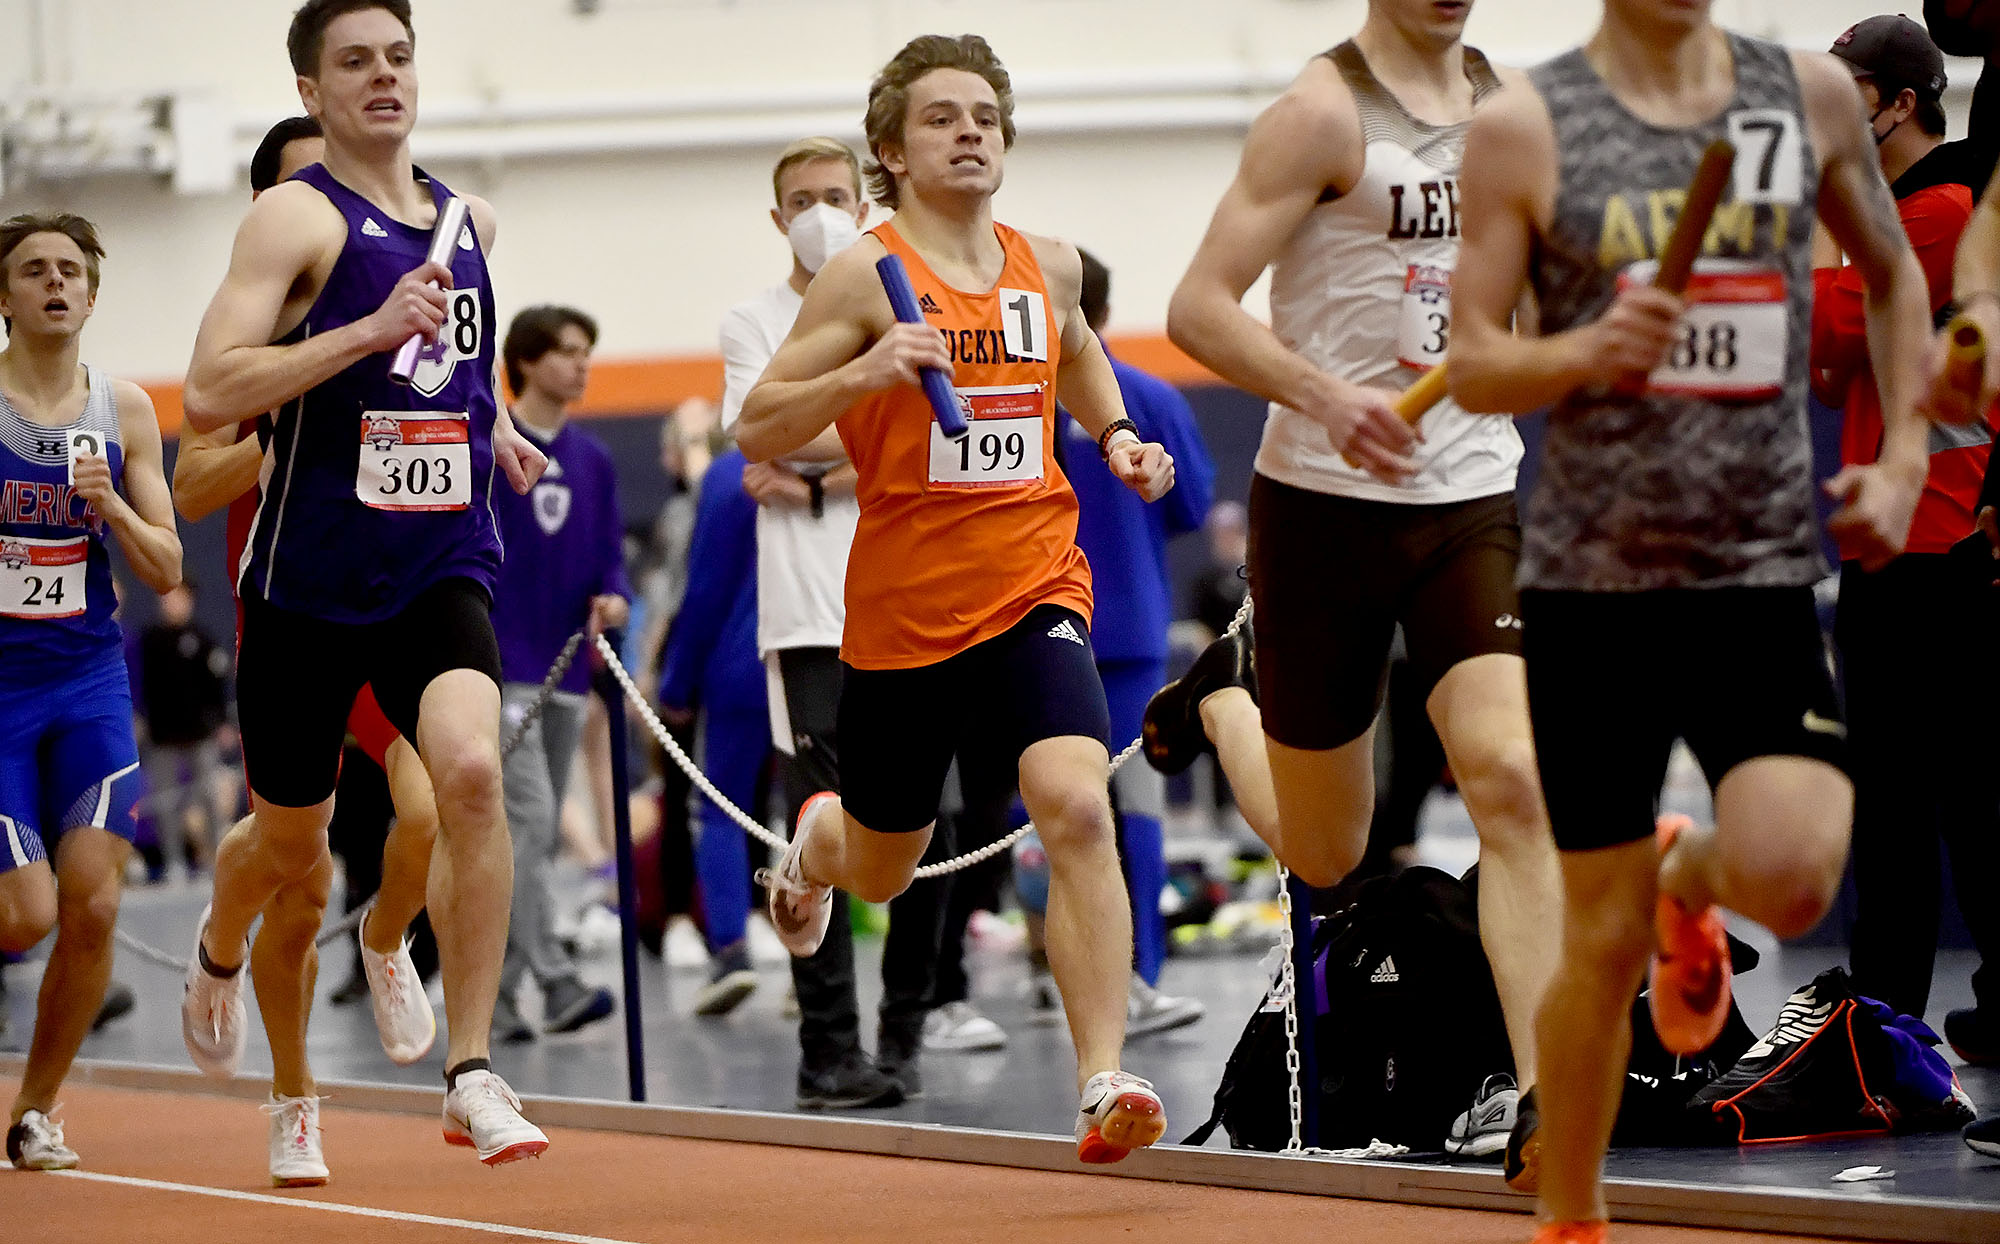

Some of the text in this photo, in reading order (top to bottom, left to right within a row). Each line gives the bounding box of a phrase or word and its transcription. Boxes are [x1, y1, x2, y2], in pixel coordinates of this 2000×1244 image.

[1742, 120, 1784, 191] 7
[1600, 188, 1790, 267] ARM
[453, 294, 477, 355] 8
[1008, 295, 1033, 353] 1
[954, 432, 1025, 471] 199
[379, 458, 453, 495] 303
[22, 576, 65, 606] 24
[1370, 972, 1400, 982] adidas
